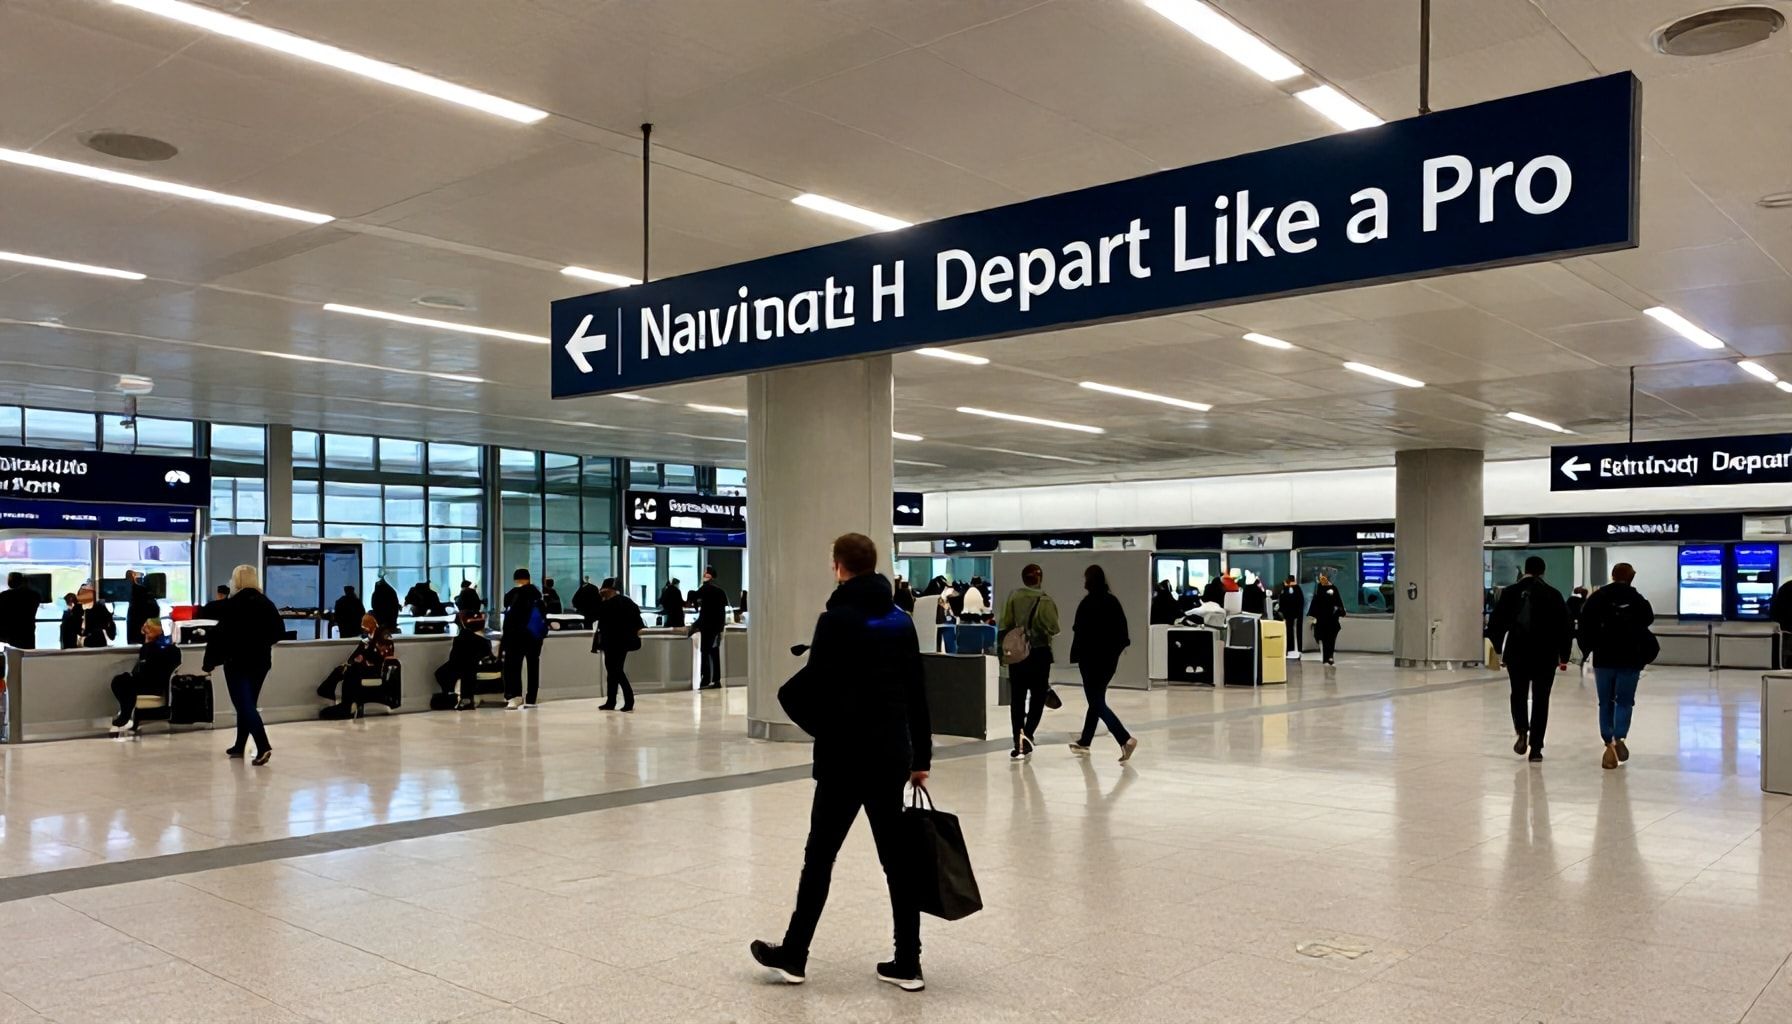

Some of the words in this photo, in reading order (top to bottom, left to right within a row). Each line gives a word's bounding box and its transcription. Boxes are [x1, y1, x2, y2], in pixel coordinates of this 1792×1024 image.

[872, 260, 905, 323] H
[936, 218, 1152, 312] Depart
[1174, 189, 1320, 272] Like
[1346, 187, 1389, 244] a
[1422, 154, 1573, 233] Pro
[1712, 447, 1792, 475] Depar
